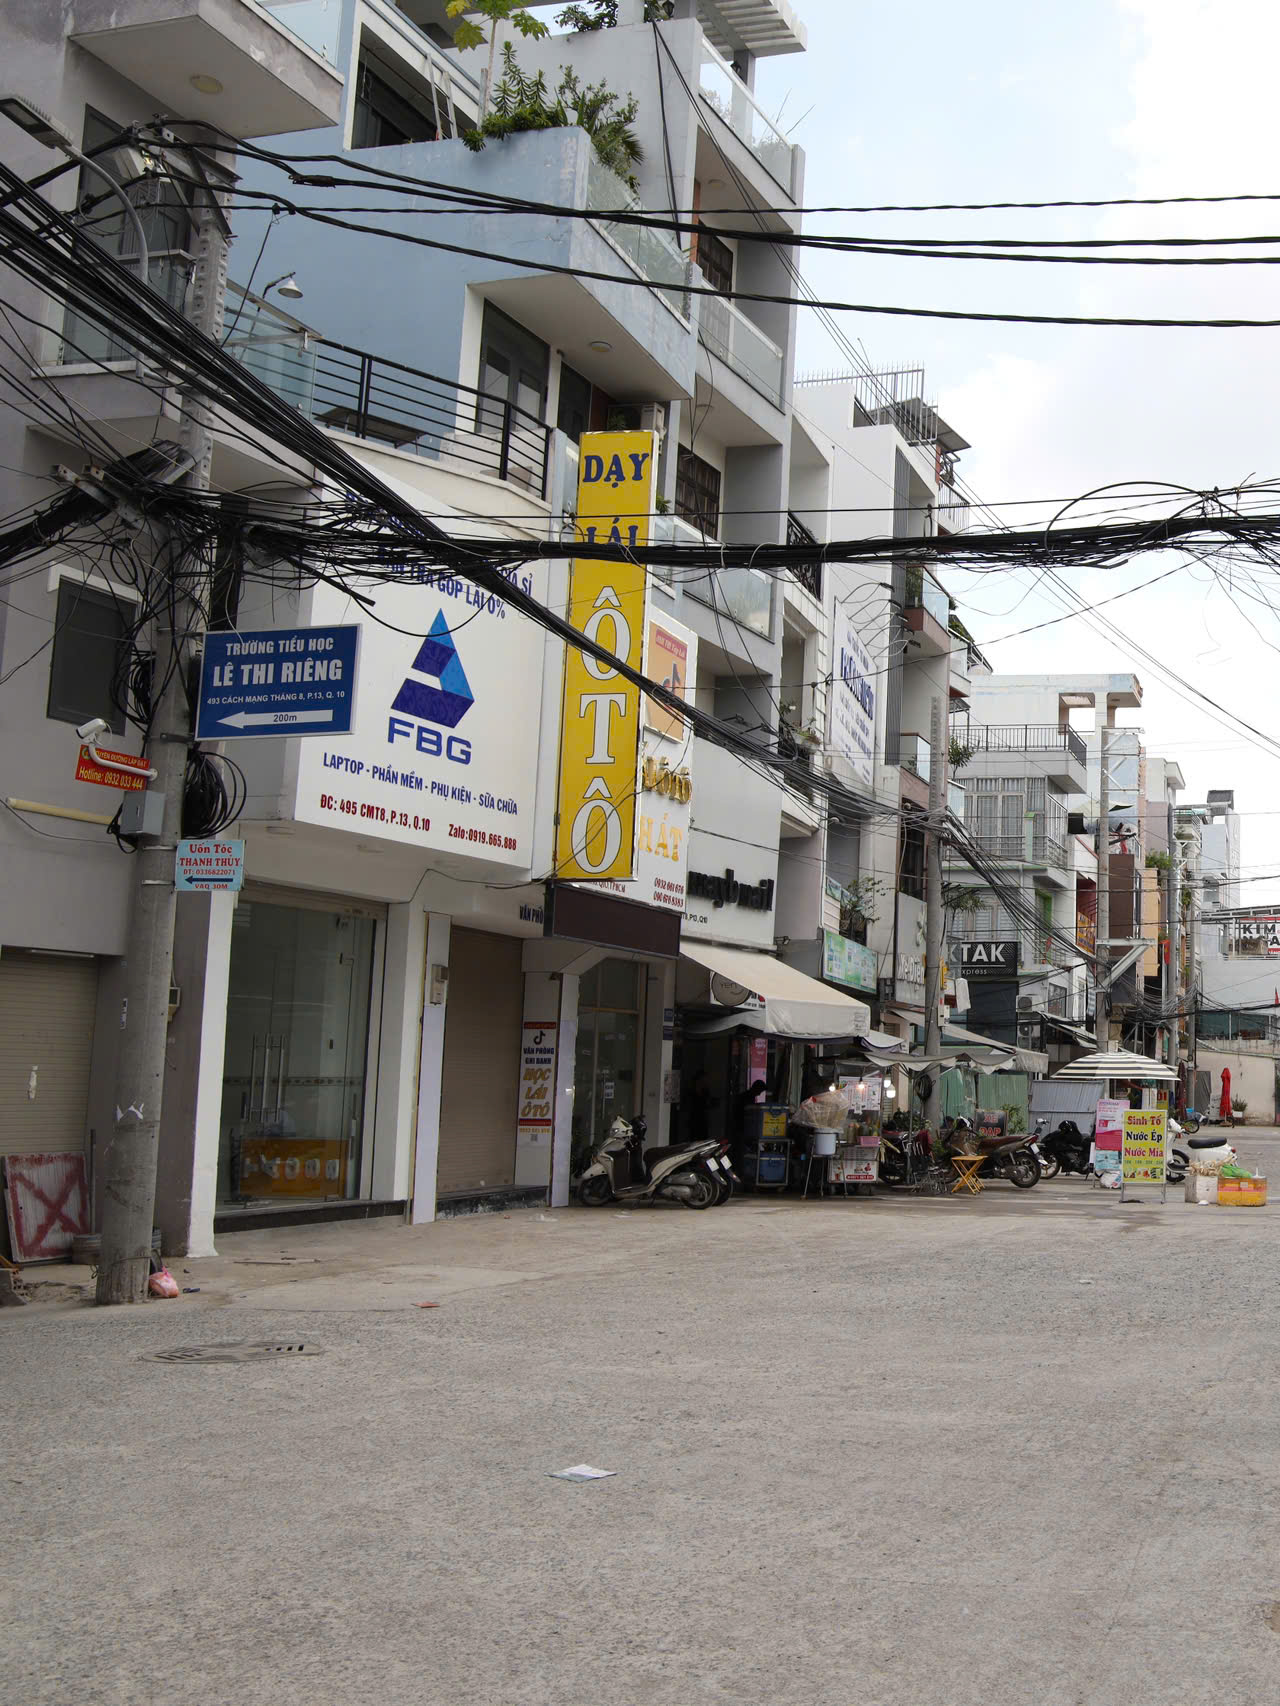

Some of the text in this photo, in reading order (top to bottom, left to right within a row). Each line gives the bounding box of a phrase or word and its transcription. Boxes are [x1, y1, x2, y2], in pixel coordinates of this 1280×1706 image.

[582, 453, 649, 488] DẠY
[487, 596, 506, 619] 0%
[226, 635, 334, 656] TRƯỜNG TIỂU HỌC
[213, 657, 343, 687] LÊ THI RIÊNG
[207, 697, 220, 705] 493
[222, 695, 244, 704] CÁCH
[245, 694, 268, 704] MẠNG
[270, 692, 297, 701] THÁNG
[336, 690, 345, 698] 10
[273, 714, 297, 722] 200m
[387, 716, 472, 765] FBG
[78, 766, 104, 782] Hotline:
[323, 752, 364, 775] LAPTOP
[372, 764, 398, 786] PHẦN
[400, 771, 423, 791] MỀM
[431, 781, 449, 803] PHỤ
[451, 786, 471, 805] KIỆN
[320, 794, 338, 811] ĐC:
[339, 799, 357, 815] 495
[360, 803, 388, 824] CMT8,
[390, 810, 411, 829] P.13,
[413, 816, 430, 831] Q.10
[189, 842, 233, 854] Uốn Tóc
[180, 857, 212, 867] THANH
[1242, 924, 1276, 934] KIM
[1127, 1113, 1162, 1126] Sinh Tố
[1126, 1129, 1163, 1143] Nước Ép
[1124, 1147, 1146, 1157] Nước
